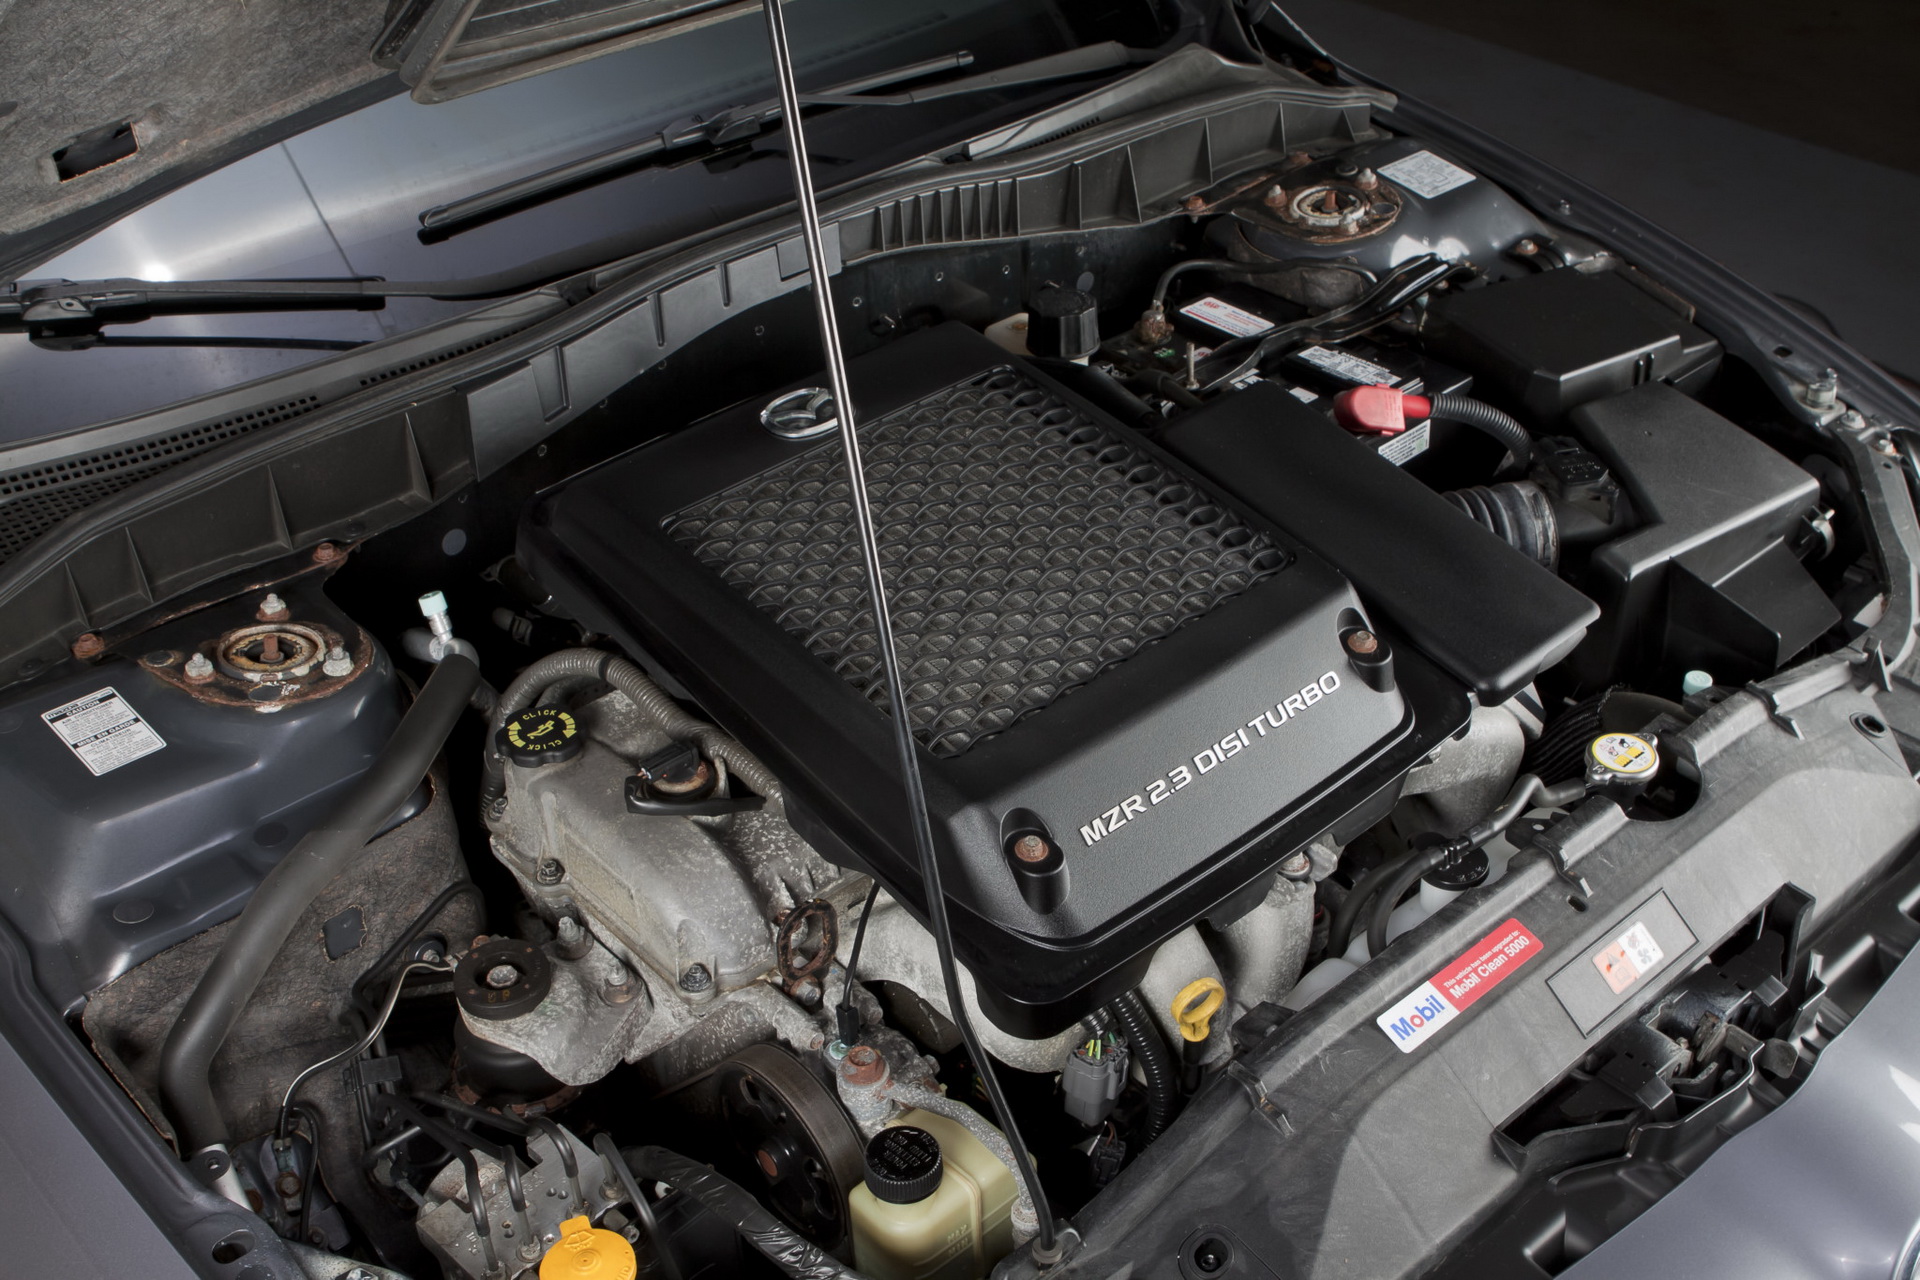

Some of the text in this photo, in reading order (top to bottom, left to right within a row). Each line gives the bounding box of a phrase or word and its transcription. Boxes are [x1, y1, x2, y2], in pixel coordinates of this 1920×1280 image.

[66, 700, 100, 716] CAUTION
[522, 709, 557, 720] CLICK
[77, 737, 96, 747] MISE
[108, 720, 135, 733] GARDE
[527, 740, 562, 750] CLICK
[1079, 671, 1341, 847] MZR 2.3 DISI TURBO
[1443, 979, 1457, 988] This
[1455, 966, 1473, 980] vehicle
[1470, 960, 1481, 968] has
[1479, 951, 1493, 962] been
[1492, 934, 1514, 953] upgraded
[1449, 936, 1529, 998] Mobil Clean 5000
[1390, 995, 1446, 1041] Mobil
